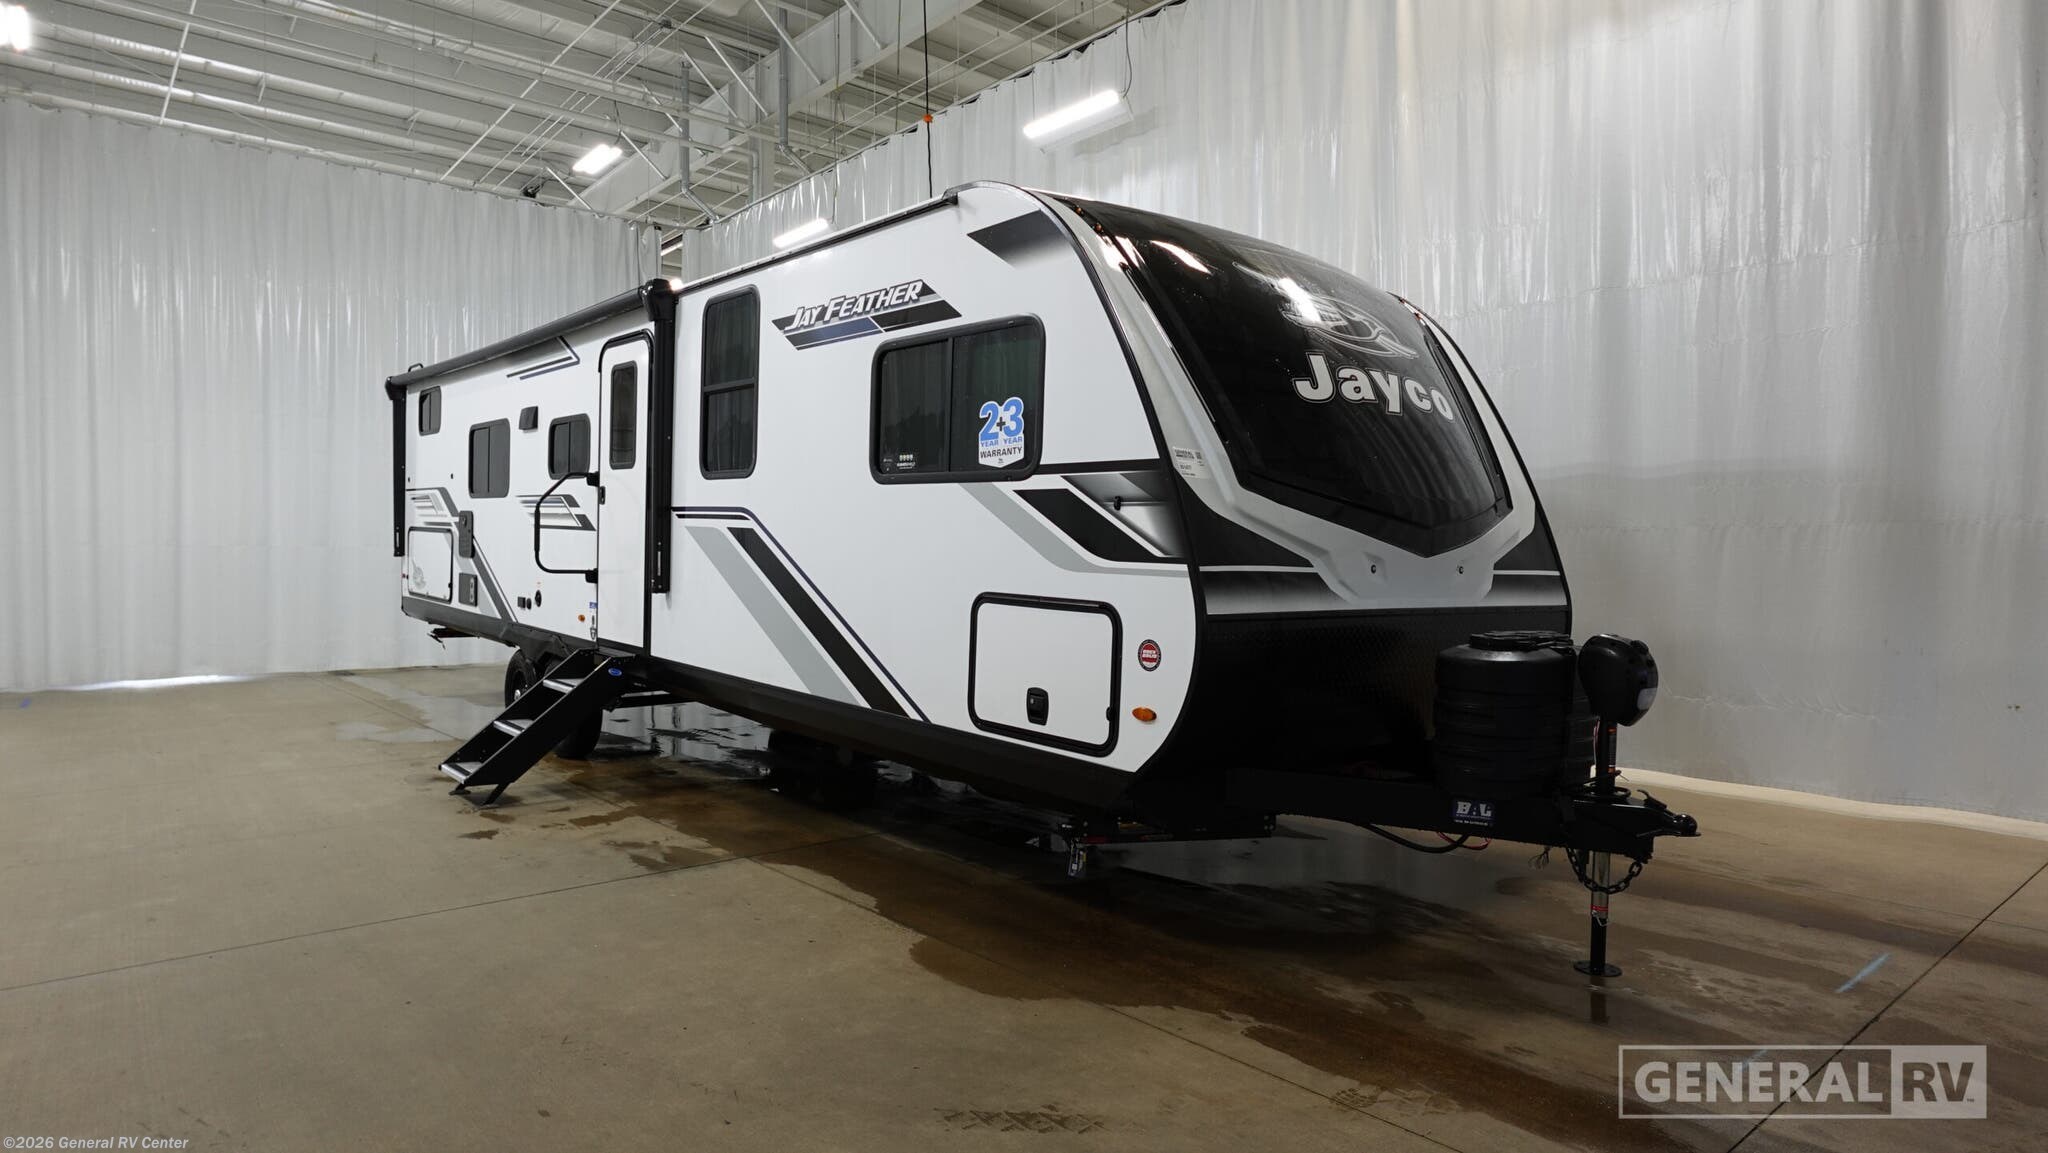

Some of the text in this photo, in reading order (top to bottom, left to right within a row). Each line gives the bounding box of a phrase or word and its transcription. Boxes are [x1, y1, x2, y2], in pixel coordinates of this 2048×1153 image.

[784, 280, 923, 333] JAY FEATHER
[1292, 352, 1454, 420] Jayco
[980, 447, 1022, 459] WARRANTY
[981, 436, 1023, 448] YEAR YEAR
